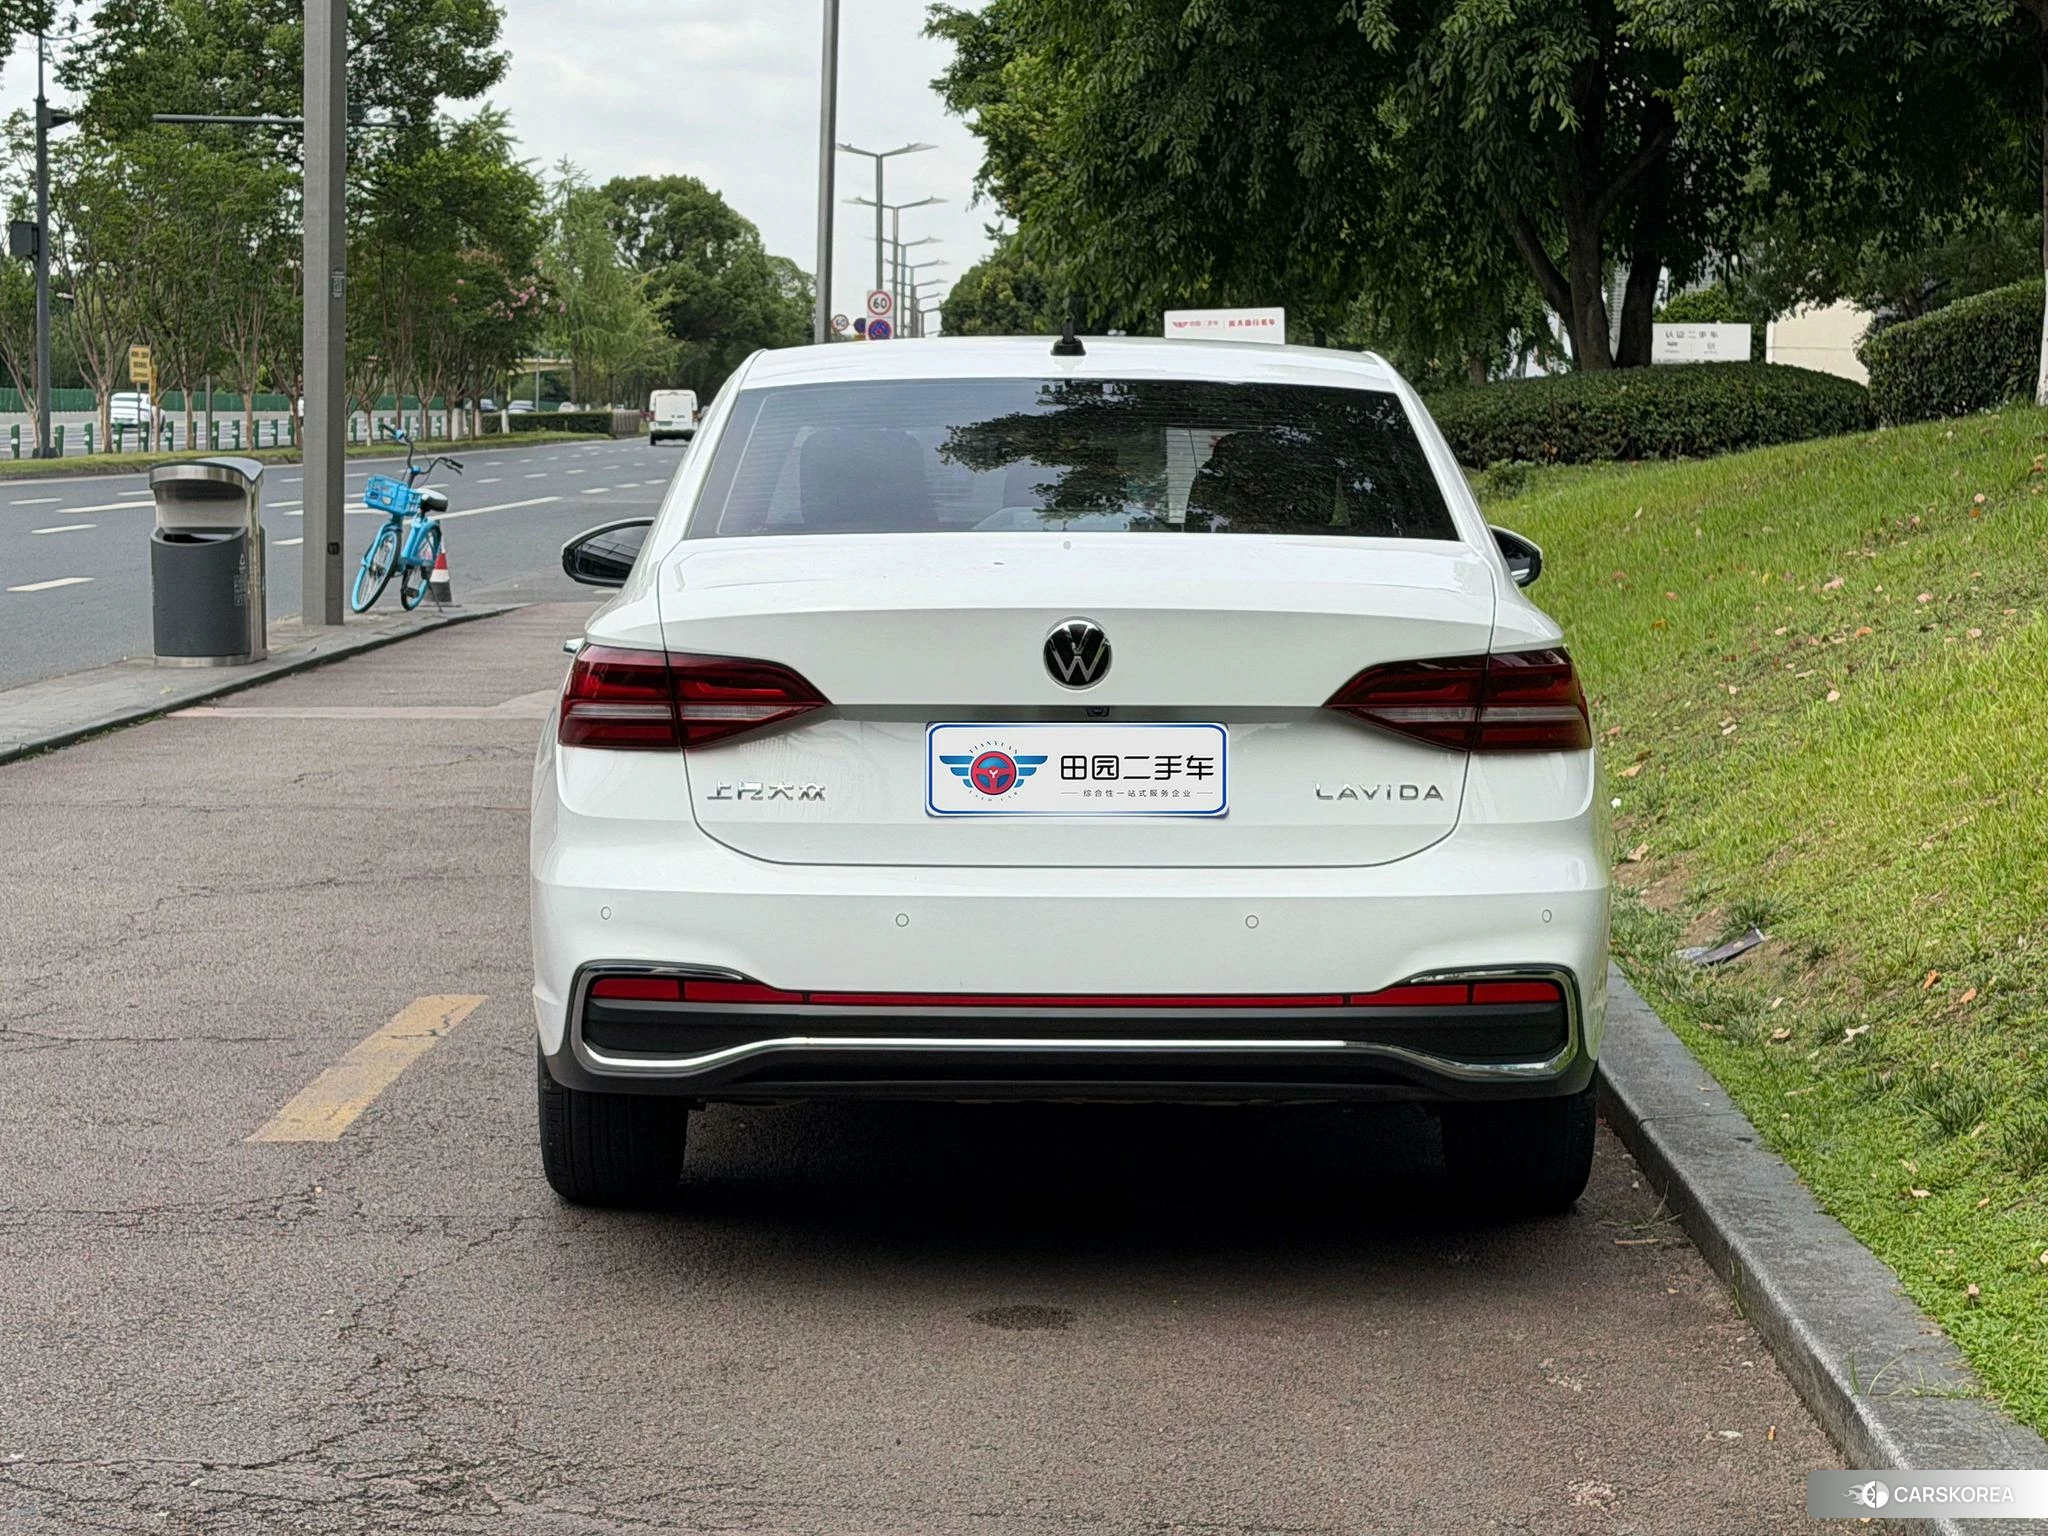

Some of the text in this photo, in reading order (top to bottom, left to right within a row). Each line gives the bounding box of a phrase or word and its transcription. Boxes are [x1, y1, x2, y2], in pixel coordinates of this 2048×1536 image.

[873, 297, 888, 309] 60
[1060, 755, 1215, 781] 田园二手车
[1083, 789, 1192, 798] 综合性一站式服务企业
[1315, 783, 1444, 801] LAVIDA
